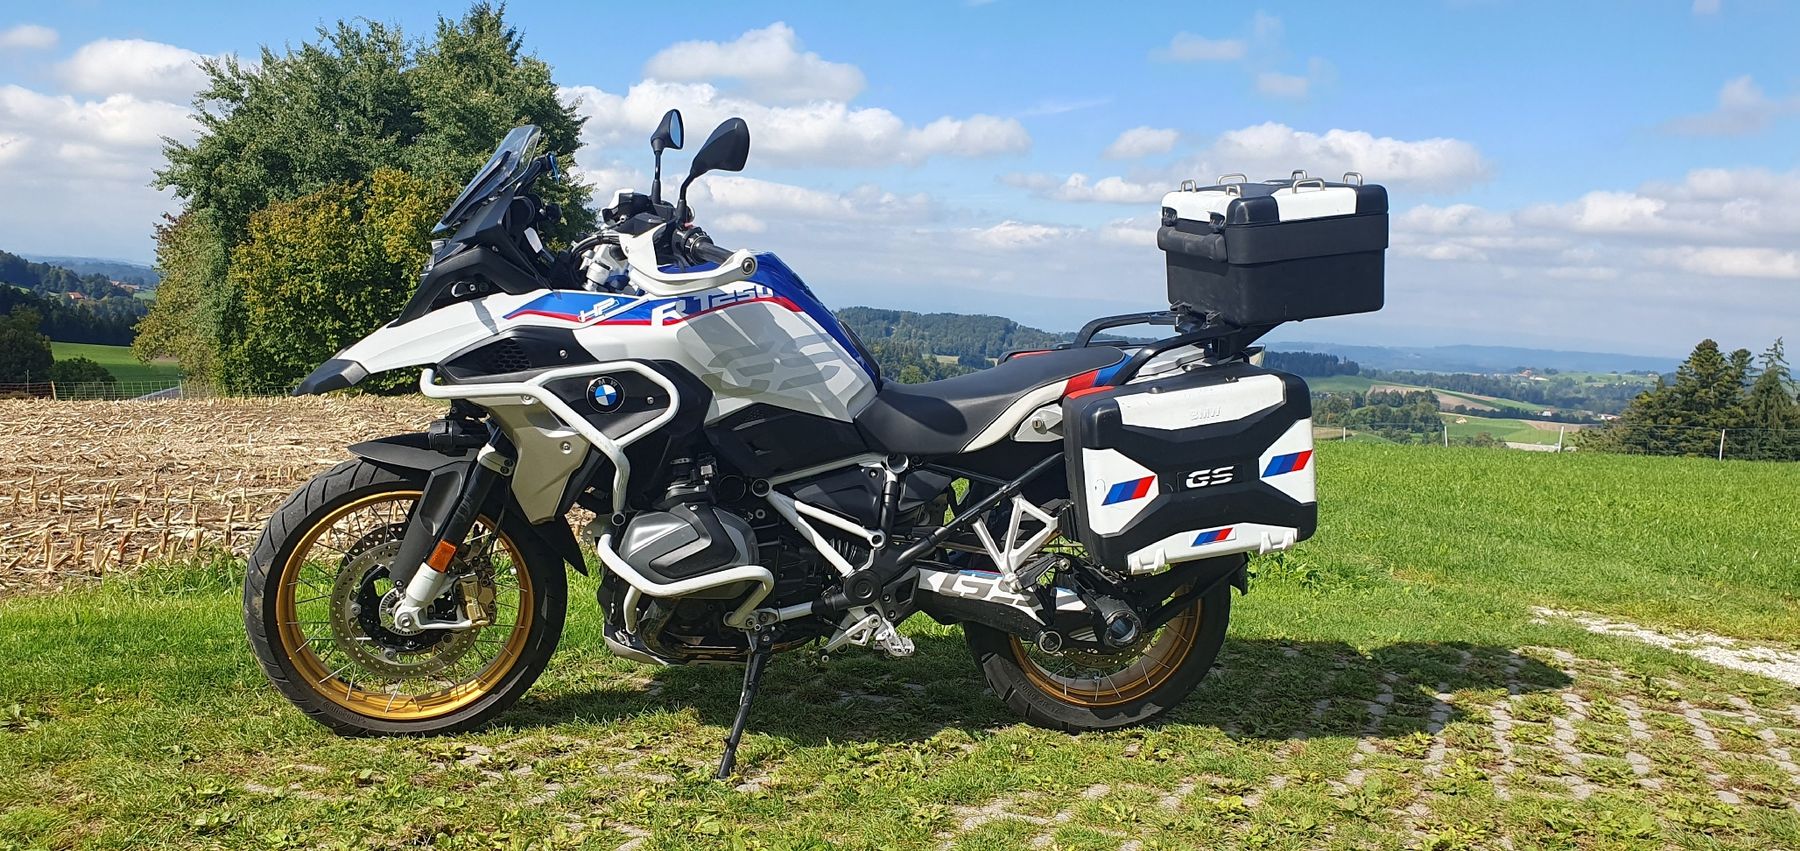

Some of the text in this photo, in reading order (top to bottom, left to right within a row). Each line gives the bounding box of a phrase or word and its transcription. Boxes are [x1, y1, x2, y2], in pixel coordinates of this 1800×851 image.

[578, 297, 620, 323] HP
[651, 300, 689, 326] R
[590, 379, 618, 393] BMW
[1190, 406, 1222, 421] BMW
[1185, 465, 1235, 489] GS
